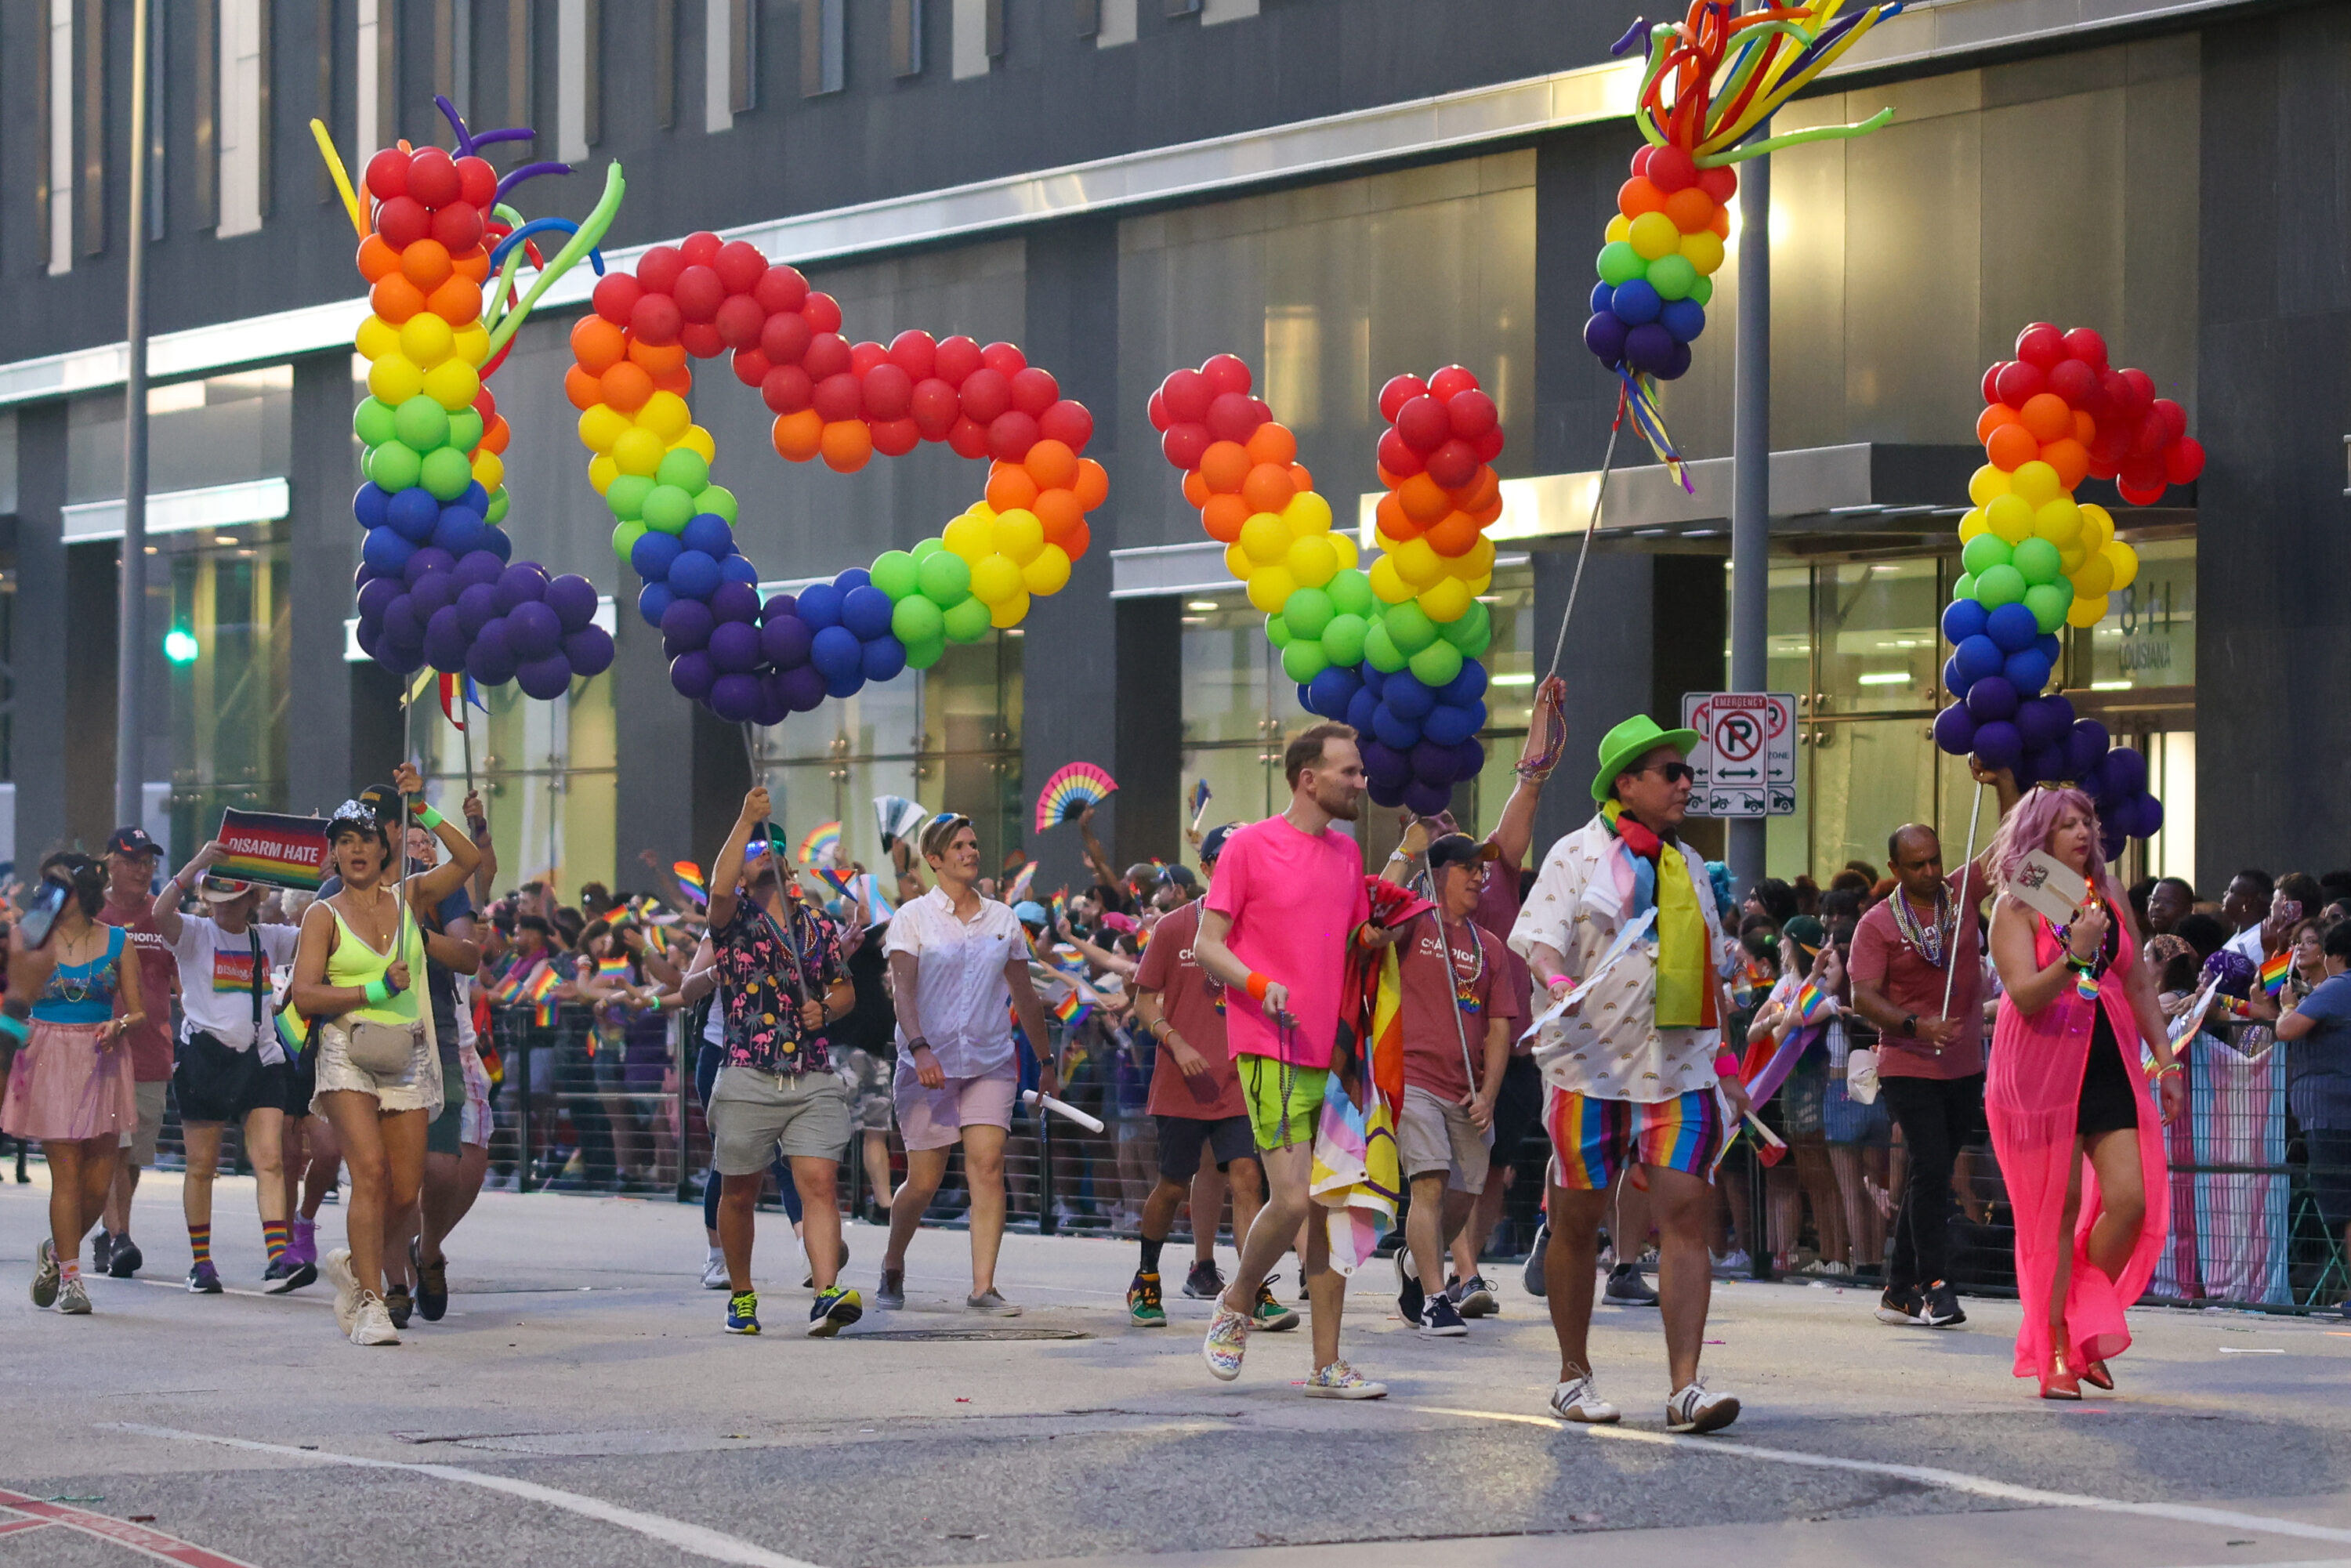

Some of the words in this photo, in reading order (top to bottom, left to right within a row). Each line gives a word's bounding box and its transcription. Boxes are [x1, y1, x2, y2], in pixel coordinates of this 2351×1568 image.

[2120, 581, 2171, 636] 811
[2118, 642, 2171, 670] LOUISIANA
[1715, 697, 1763, 708] EMERGENCY
[230, 837, 282, 857] DISARM
[283, 844, 319, 863] HATE
